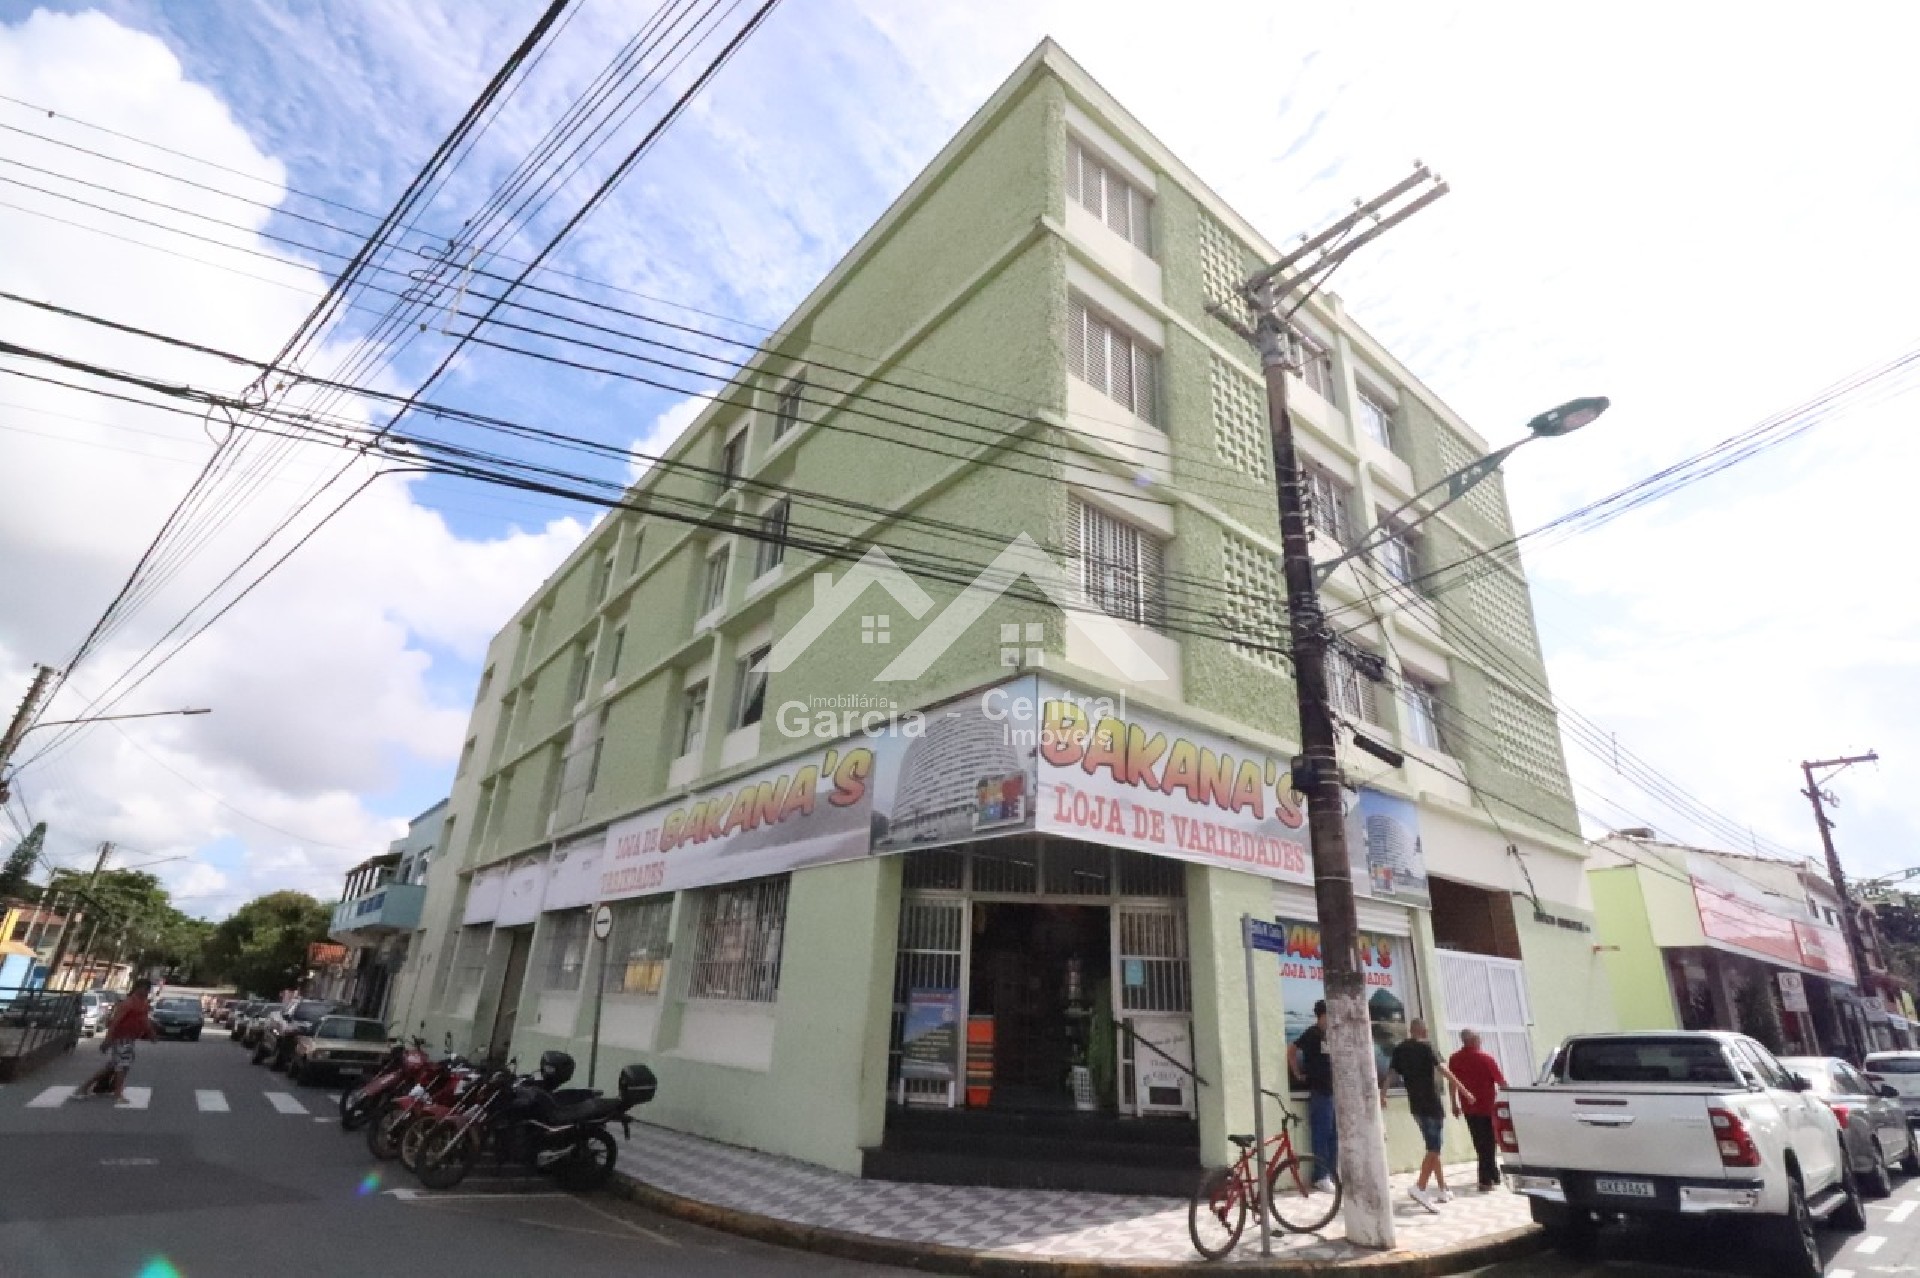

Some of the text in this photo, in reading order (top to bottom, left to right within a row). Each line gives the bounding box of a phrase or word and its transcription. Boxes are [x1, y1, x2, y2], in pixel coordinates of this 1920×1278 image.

[660, 748, 874, 853] BAKANA'S
[1041, 700, 1304, 829] BAKANA'S
[1053, 786, 1306, 875] LOJA DE VARIEDADES
